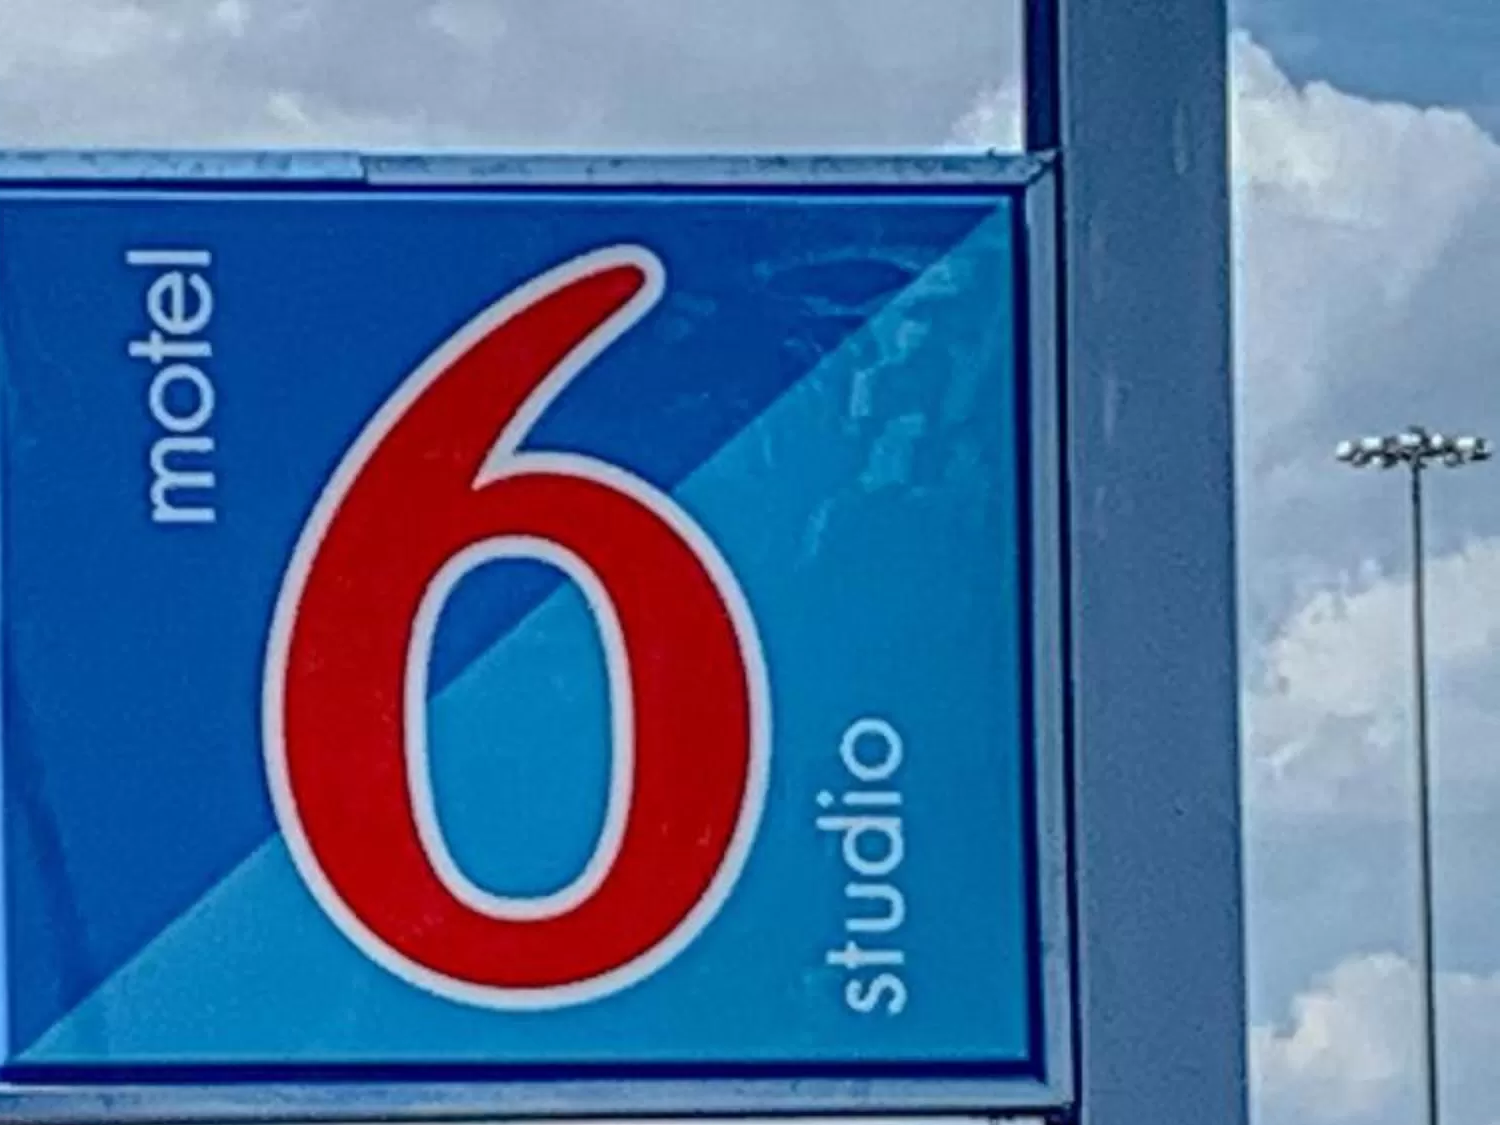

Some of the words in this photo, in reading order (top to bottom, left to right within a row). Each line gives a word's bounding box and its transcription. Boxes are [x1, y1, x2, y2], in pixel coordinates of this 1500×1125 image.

[125, 248, 215, 523] motel
[261, 242, 773, 1012] 6
[815, 716, 905, 1015] studio
